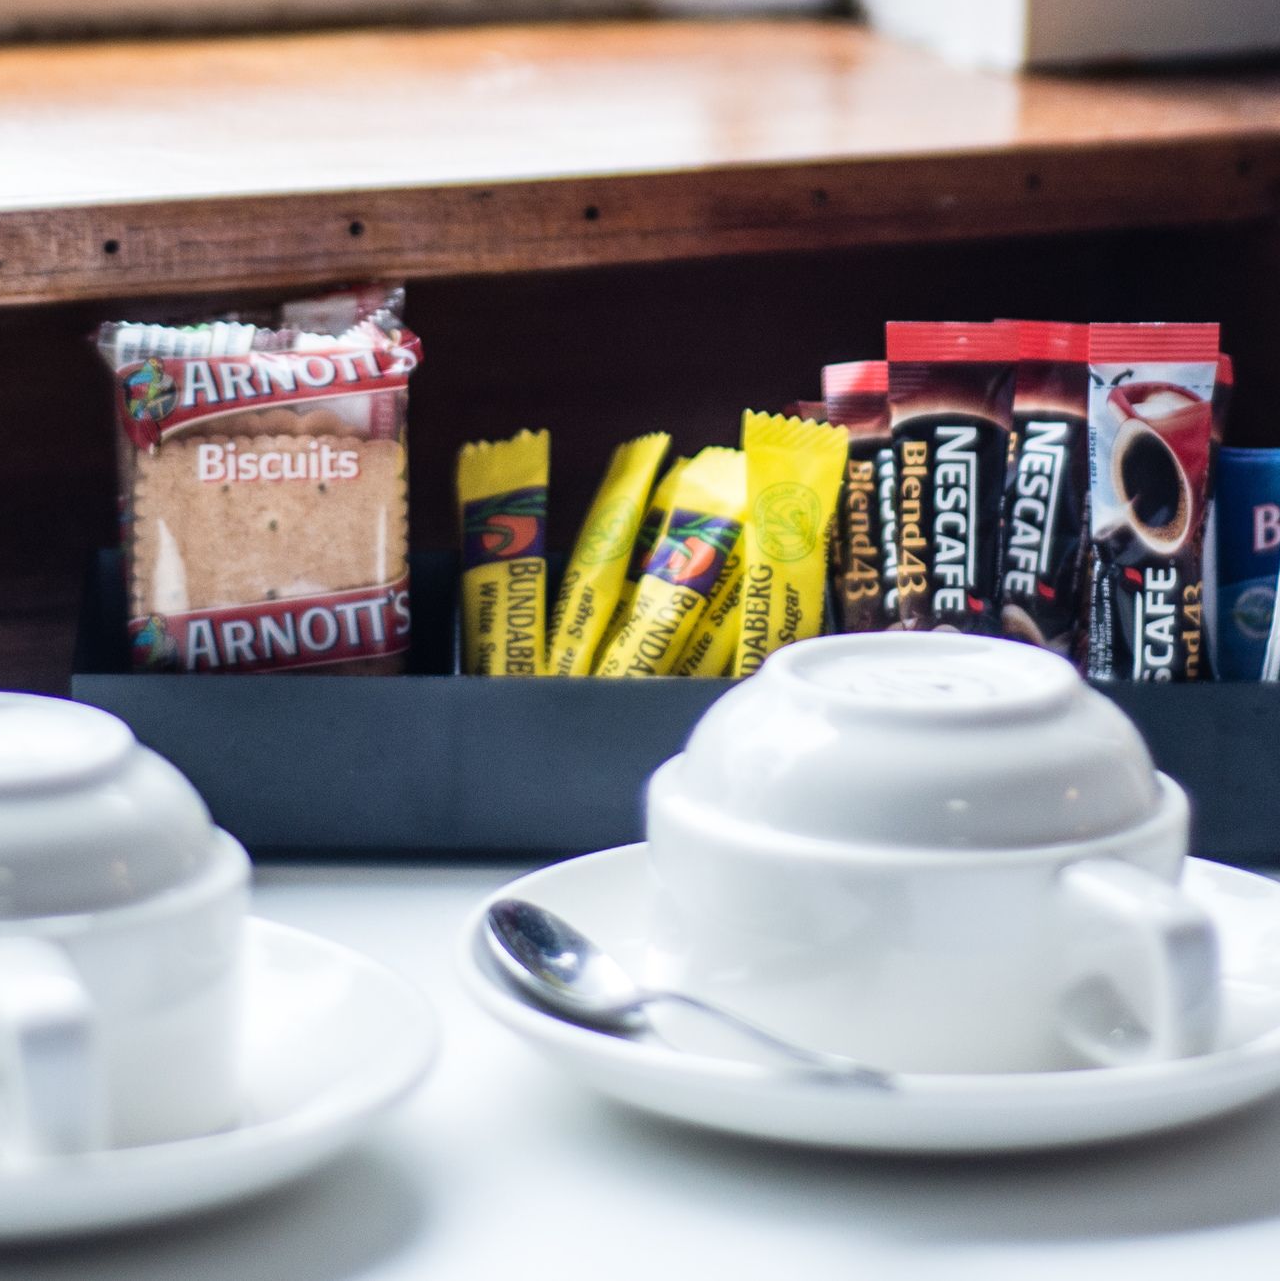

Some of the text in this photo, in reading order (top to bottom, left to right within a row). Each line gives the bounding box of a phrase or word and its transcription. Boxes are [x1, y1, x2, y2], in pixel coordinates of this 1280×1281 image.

[182, 346, 418, 407] ARNOTTS
[197, 443, 361, 482] Biscuits
[1101, 574, 1110, 598] sale.
[567, 585, 595, 639] Sugar
[778, 582, 802, 642] Sugar
[1103, 599, 1112, 645] individual
